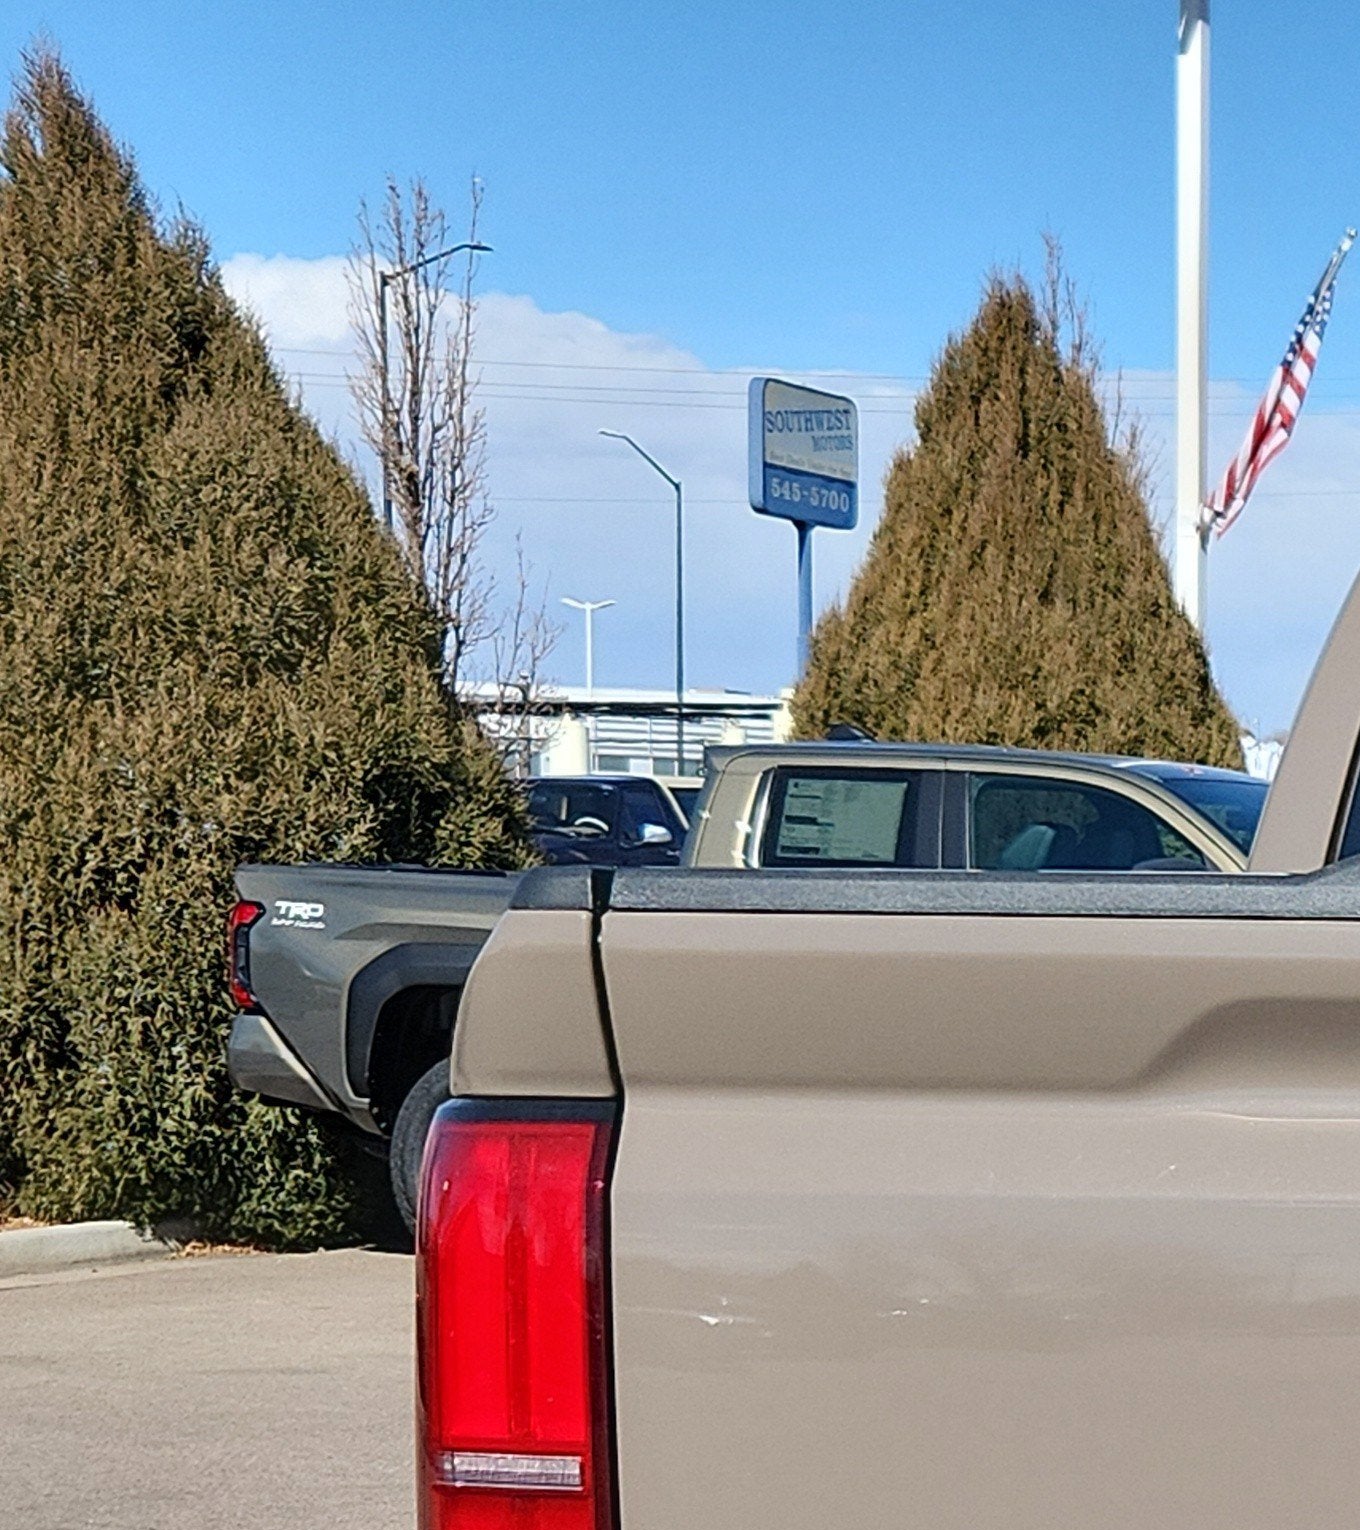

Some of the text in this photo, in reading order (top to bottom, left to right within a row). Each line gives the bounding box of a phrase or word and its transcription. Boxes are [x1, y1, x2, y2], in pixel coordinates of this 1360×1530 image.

[765, 409, 851, 433] SOUTHWEST
[771, 479, 849, 512] 545-5700
[274, 900, 324, 920] TRD
